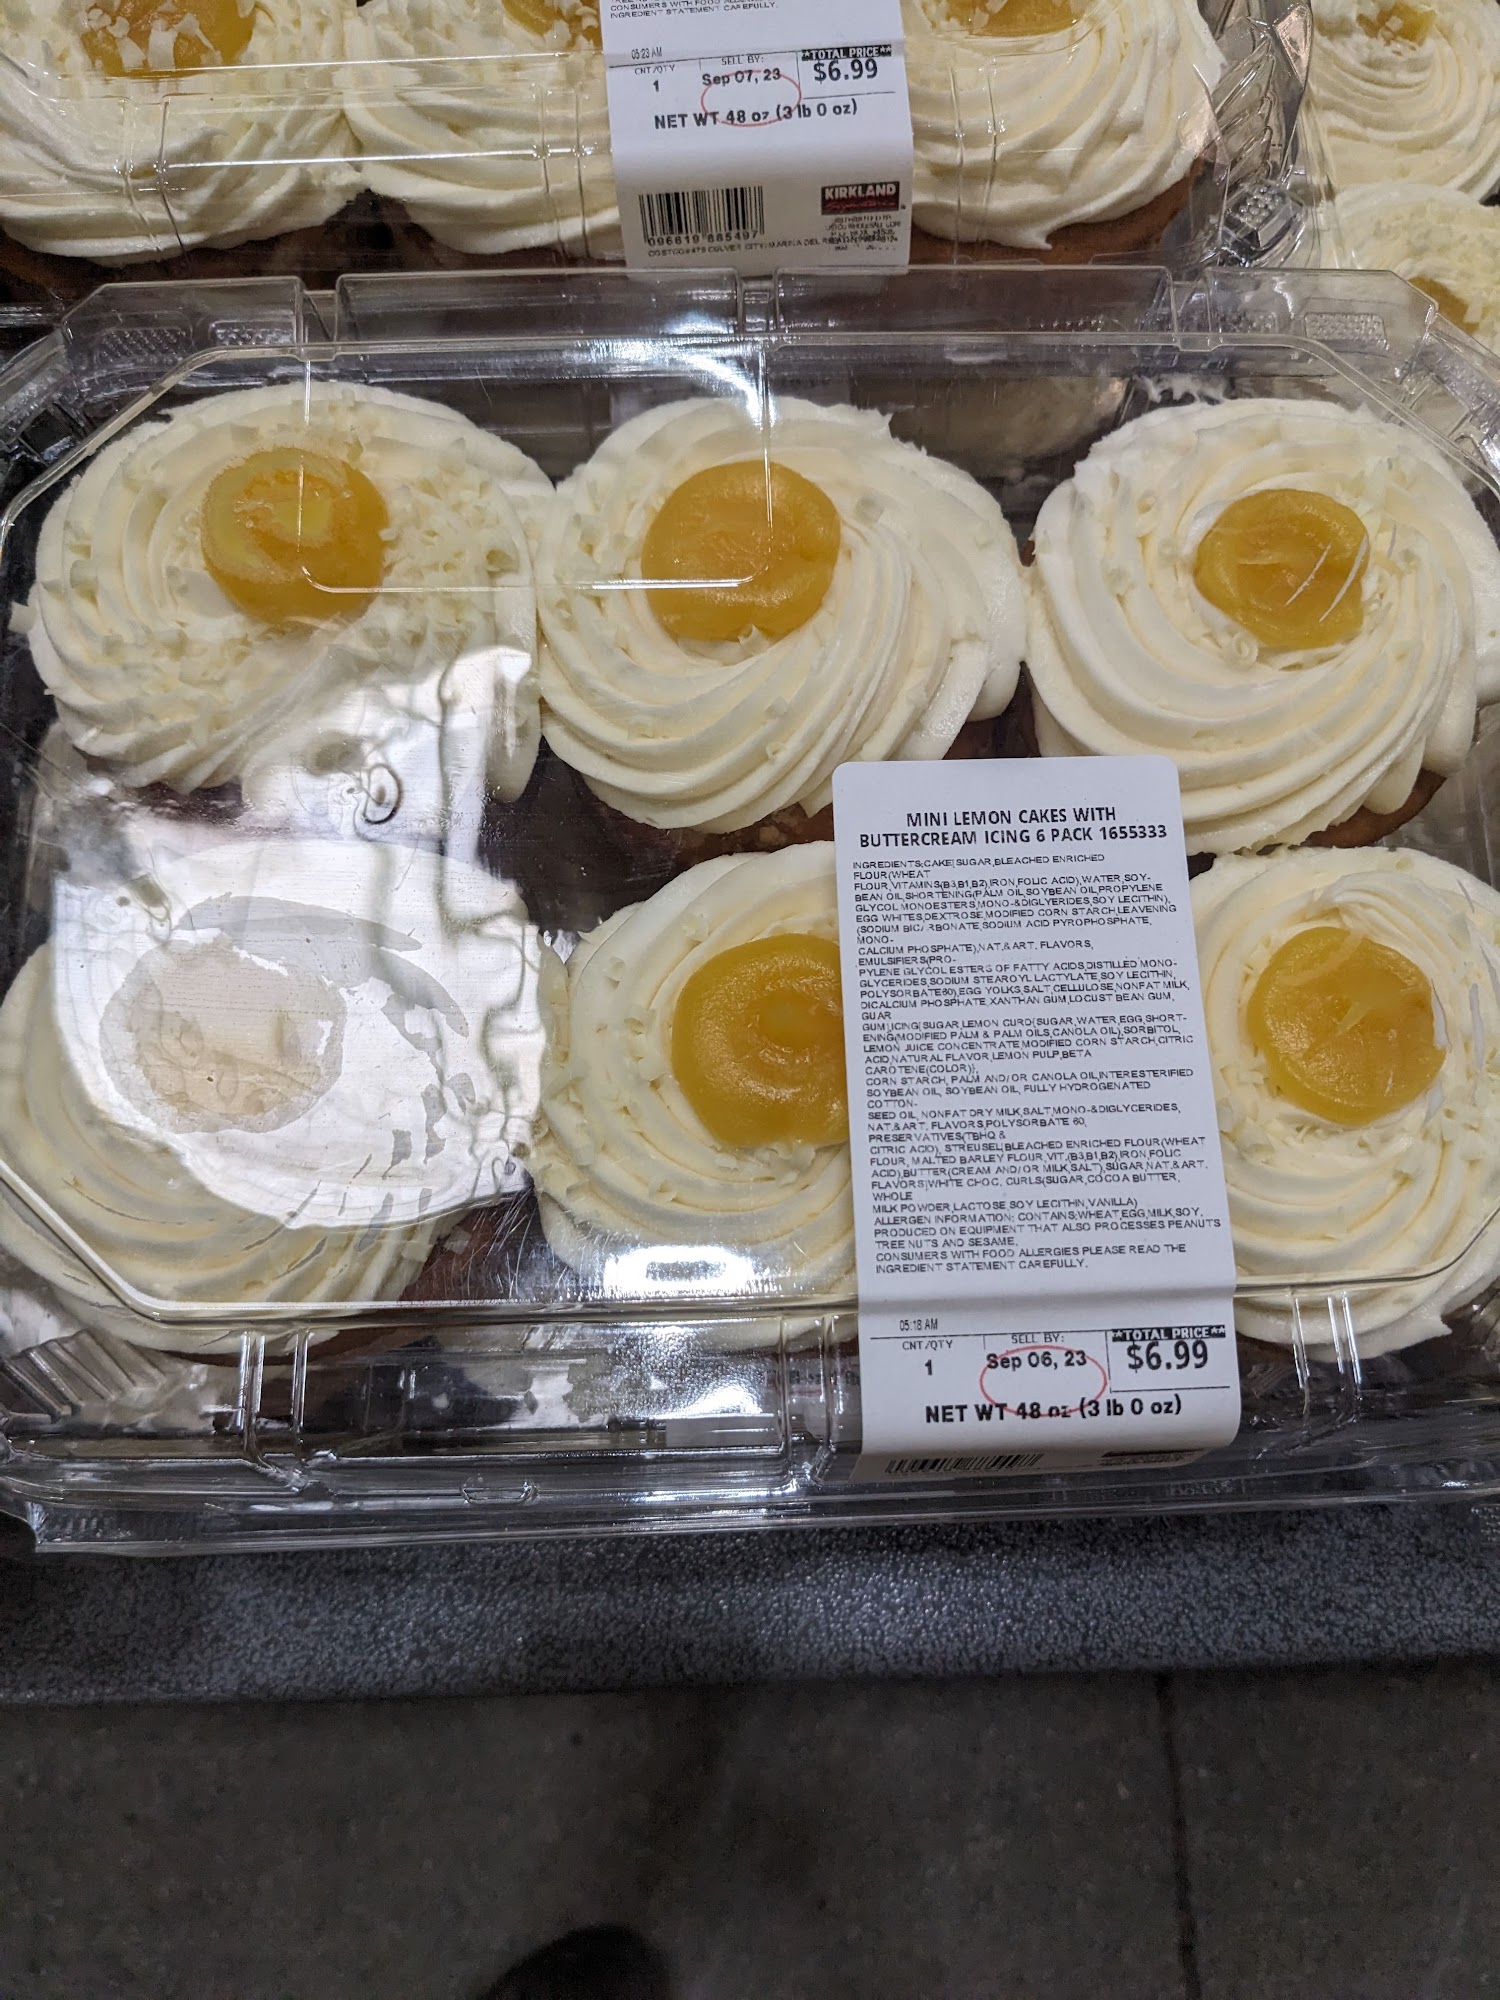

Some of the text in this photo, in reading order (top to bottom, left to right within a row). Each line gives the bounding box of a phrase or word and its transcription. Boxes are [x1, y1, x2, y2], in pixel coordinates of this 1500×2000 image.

[652, 47, 662, 58] AM
[722, 58, 742, 66] SELL
[634, 64, 675, 75] CNT/QTY
[814, 58, 878, 84] $6.99
[702, 68, 781, 88] Sep 07, 23
[653, 80, 660, 92] 1
[654, 98, 857, 129] NET WT 48 oz (3 lb 0 oz)
[824, 184, 896, 200] KIRKLAND
[906, 806, 1116, 826] MINI LEMON CAKES WITH
[860, 825, 1167, 847] BUTTERCREAM ICING 6 PACK 1655333
[1053, 855, 1104, 863] ENRICHED
[855, 893, 883, 901] BEAN
[856, 903, 898, 912] GLYCOL
[857, 908, 1068, 922] EGG CORN
[1026, 920, 1049, 928] ACID
[857, 936, 893, 944] MONO-
[859, 946, 903, 955] CALCIUM
[859, 959, 1177, 976] PYLENE GLYCOL ESTERS OF FATTY MONO-
[974, 974, 1032, 984] STEAROYL
[861, 1000, 916, 1009] DICALCIUM
[1116, 993, 1144, 1001] BEAN
[862, 1011, 891, 1020] GUAR
[951, 1031, 978, 1039] PALM
[994, 1030, 1022, 1038] PALM
[864, 1038, 1106, 1052] LEMON JUICE CORN
[866, 1077, 896, 1085] CORN
[952, 1075, 979, 1083] PALM
[985, 1074, 1027, 1082] AND/OR
[1032, 1072, 1076, 1081] CANOLA
[867, 1088, 918, 1096] SOYBEAN
[946, 1086, 997, 1094] SOYBEAN
[1024, 1084, 1055, 1092] FULLY
[1060, 1081, 1150, 1091] HYDROGENATED
[868, 1099, 917, 1108] COTTON-
[868, 1111, 895, 1119] SEED
[922, 1109, 967, 1118] NONFAT
[970, 1109, 993, 1117] DRY
[999, 1131, 1005, 1139] &
[870, 1146, 905, 1154] CITRIC
[1066, 1140, 1120, 1149] ENRICHED
[912, 1156, 956, 1165] MALTED
[960, 1155, 1004, 1163] BARLEY
[995, 1165, 1038, 1174] AND/OR
[873, 1192, 913, 1201] WHOLE
[873, 1204, 897, 1212] MILK
[874, 1216, 930, 1225] ALLERGEN
[875, 1220, 1220, 1237] PRODUCED ON EQUIPMENT THAT ALSO PROCESSES PEANUTS
[876, 1240, 905, 1249] TREE
[908, 1239, 938, 1248] NUTS
[942, 1239, 964, 1247] AND
[877, 1244, 1186, 1261] CONSUMERS WITH FOOD ALLERGIES PLEASE READ THE
[877, 1259, 1088, 1273] INGREDIENT STATEMENT CAREFULLY.
[900, 1318, 938, 1331] 05:18 AM
[1011, 1333, 1064, 1344] SELL BY:
[902, 1340, 952, 1350] CNT/QTY
[986, 1350, 1087, 1371] Sep 06, 23
[1127, 1340, 1208, 1373] $6.99
[925, 1359, 932, 1376] 1
[926, 1393, 1182, 1423] NET WT 48 oz (3 lb 0 oz)
